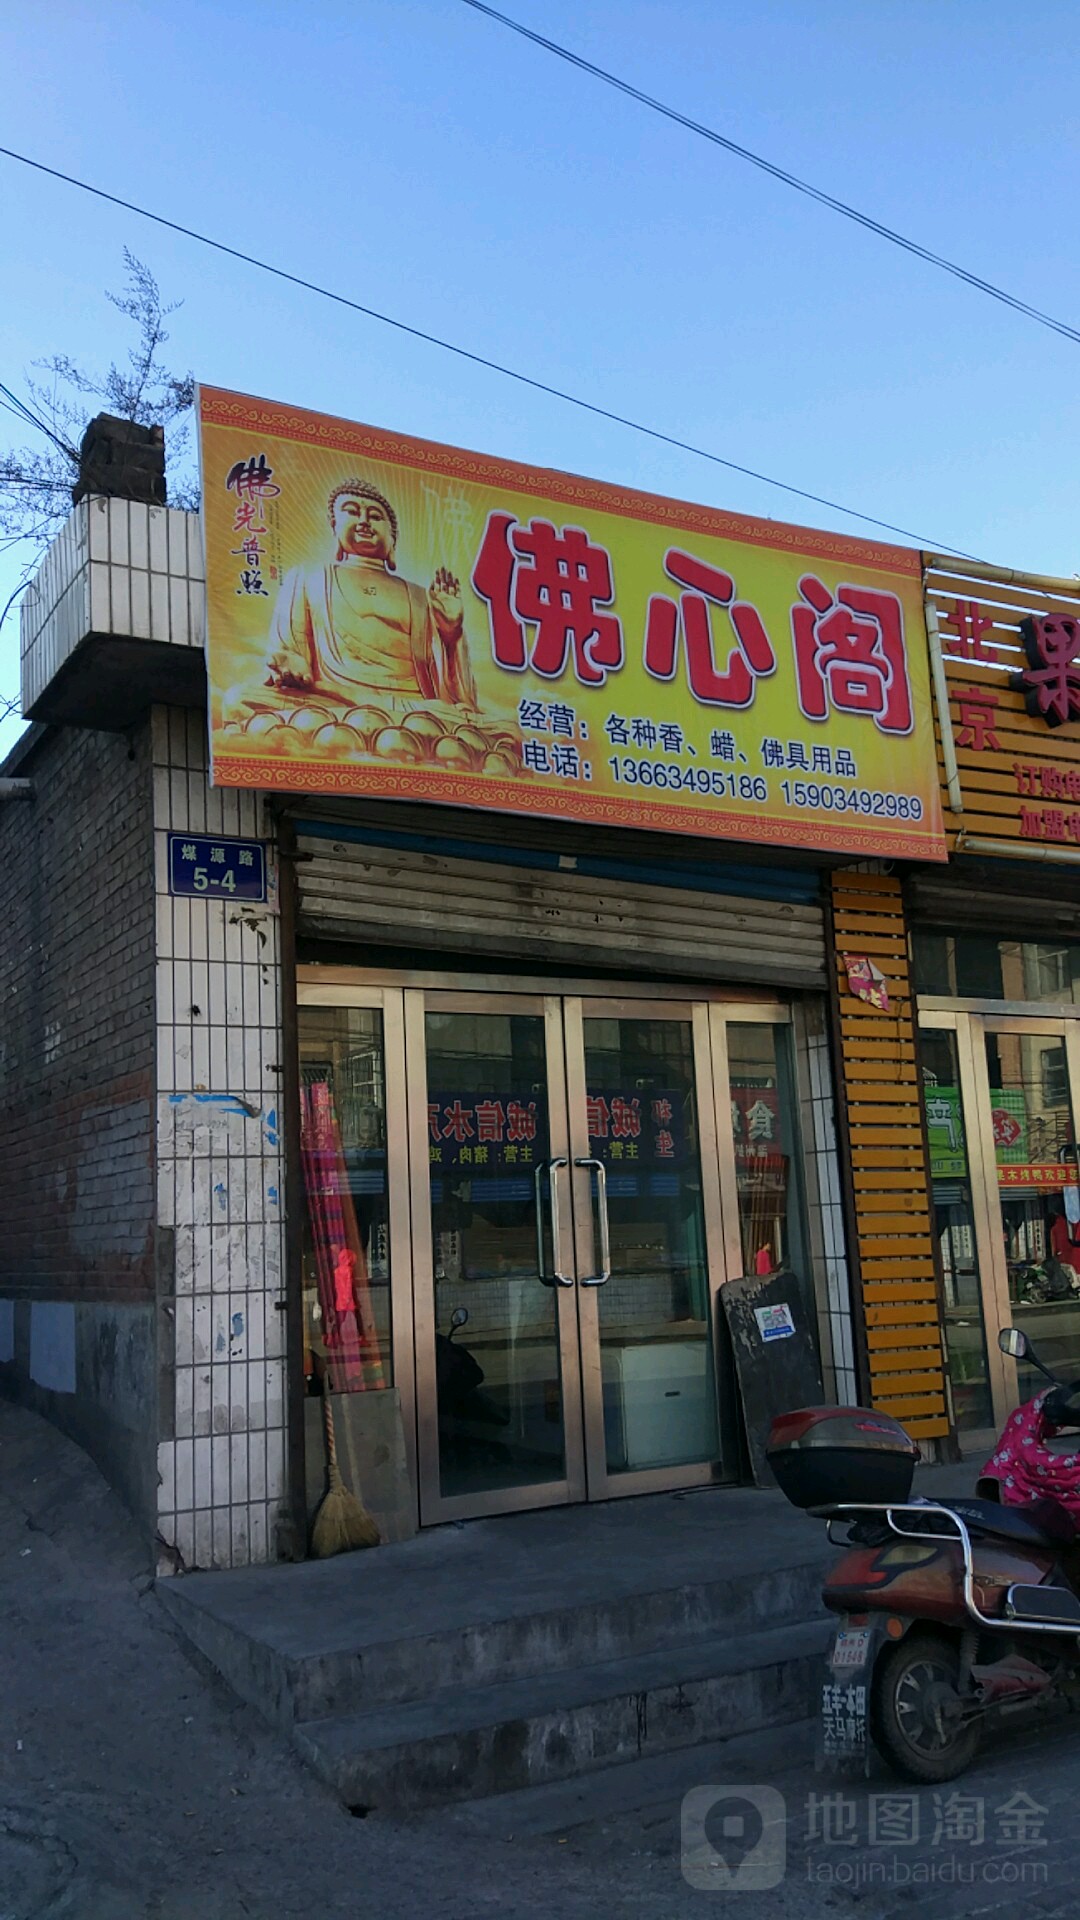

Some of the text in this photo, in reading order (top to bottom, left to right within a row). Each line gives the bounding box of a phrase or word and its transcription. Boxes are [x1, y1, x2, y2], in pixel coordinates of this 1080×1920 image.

[226, 453, 282, 597] 佛光普照
[472, 510, 914, 735] 佛心阁
[946, 599, 1000, 750] 北京
[604, 714, 857, 778] 各种香、蜡、佛具用品
[608, 757, 767, 802] 13663495186
[780, 781, 923, 822] 15903492989
[193, 867, 237, 893] 5-4
